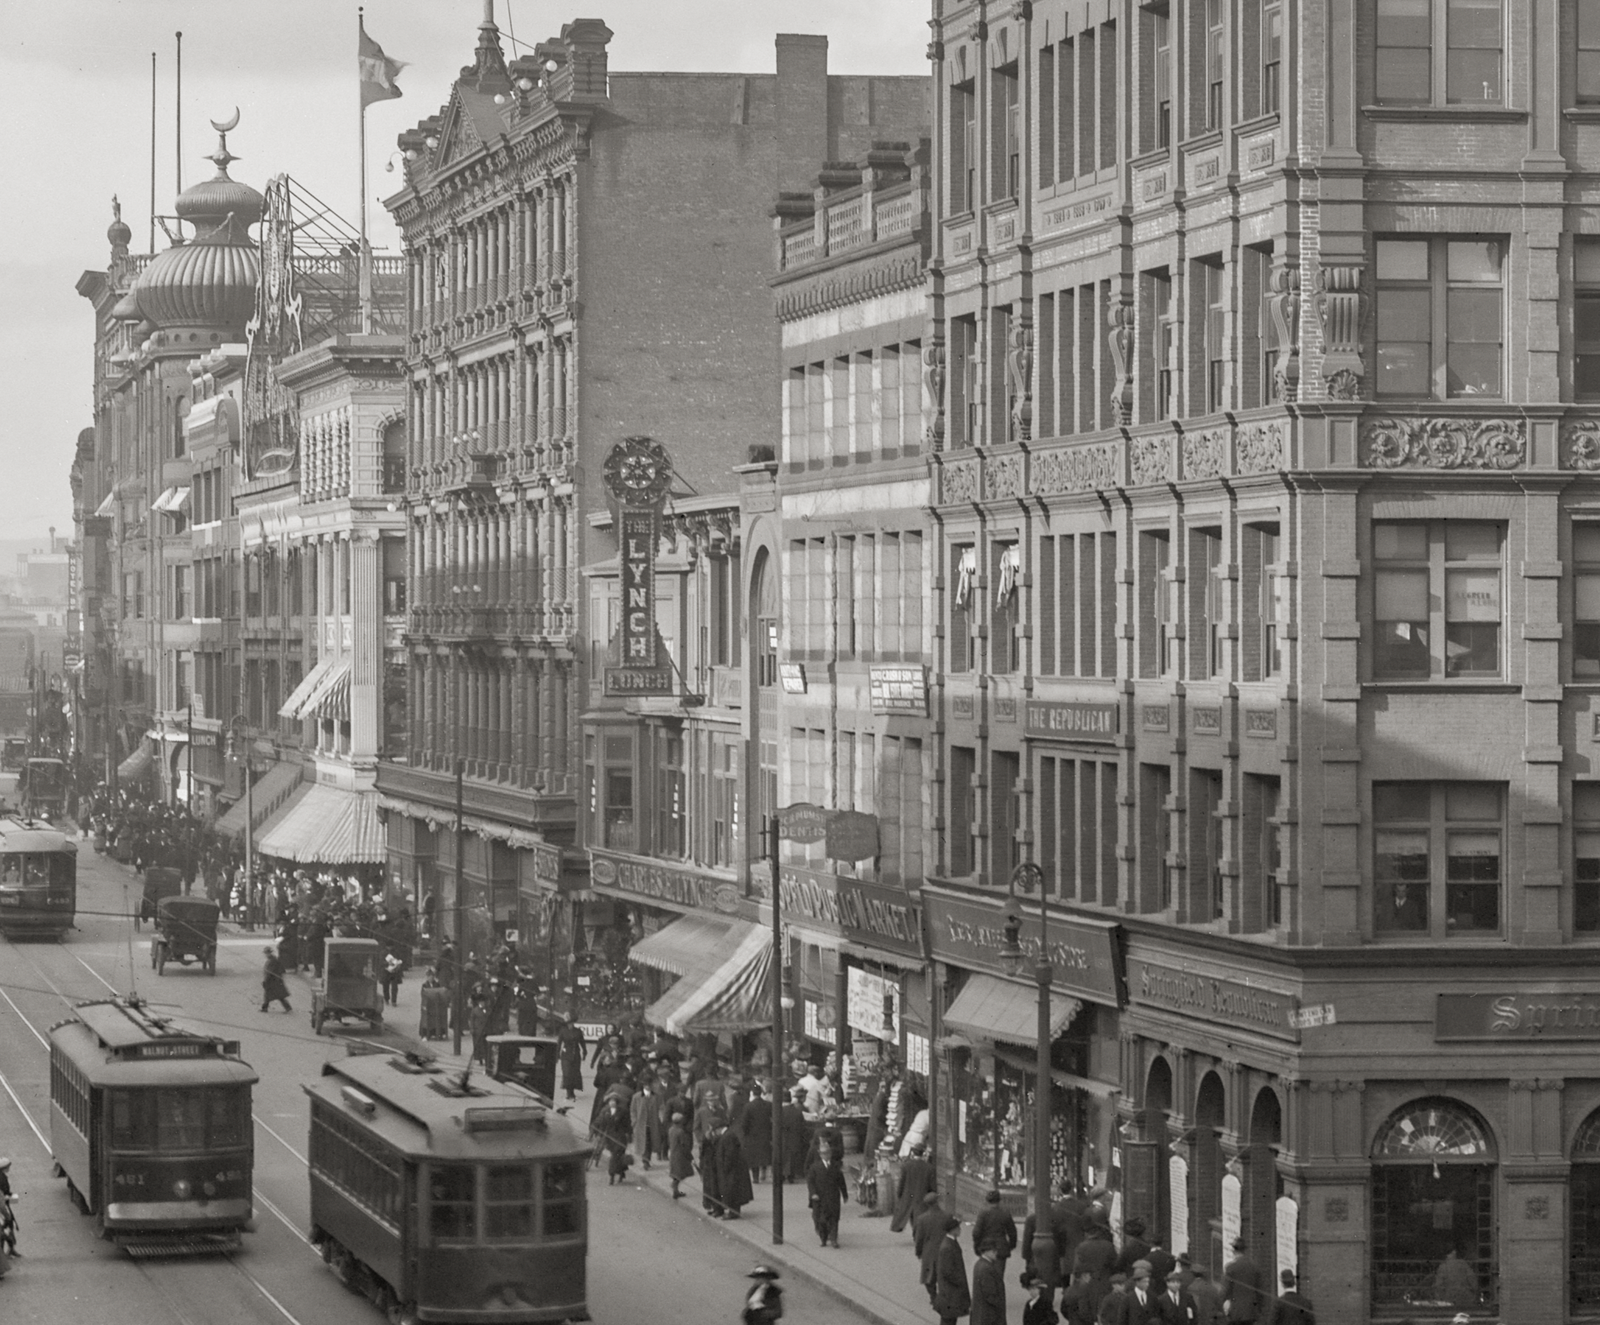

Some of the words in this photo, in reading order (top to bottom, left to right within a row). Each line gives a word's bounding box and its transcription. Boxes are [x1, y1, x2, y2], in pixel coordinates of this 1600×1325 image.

[627, 538, 647, 657] LYNCH
[608, 673, 669, 689] LUNCH
[1029, 707, 1046, 729] THE
[1049, 707, 1111, 733] REPUBLICAN
[191, 734, 217, 746] LUNCH
[779, 825, 827, 838] DENTIS
[618, 862, 664, 898] CHARLES
[676, 874, 714, 908] LYNCH
[808, 878, 858, 930] PUBLIC
[1141, 964, 1206, 1009] Springfield
[172, 1044, 200, 1056] STREET
